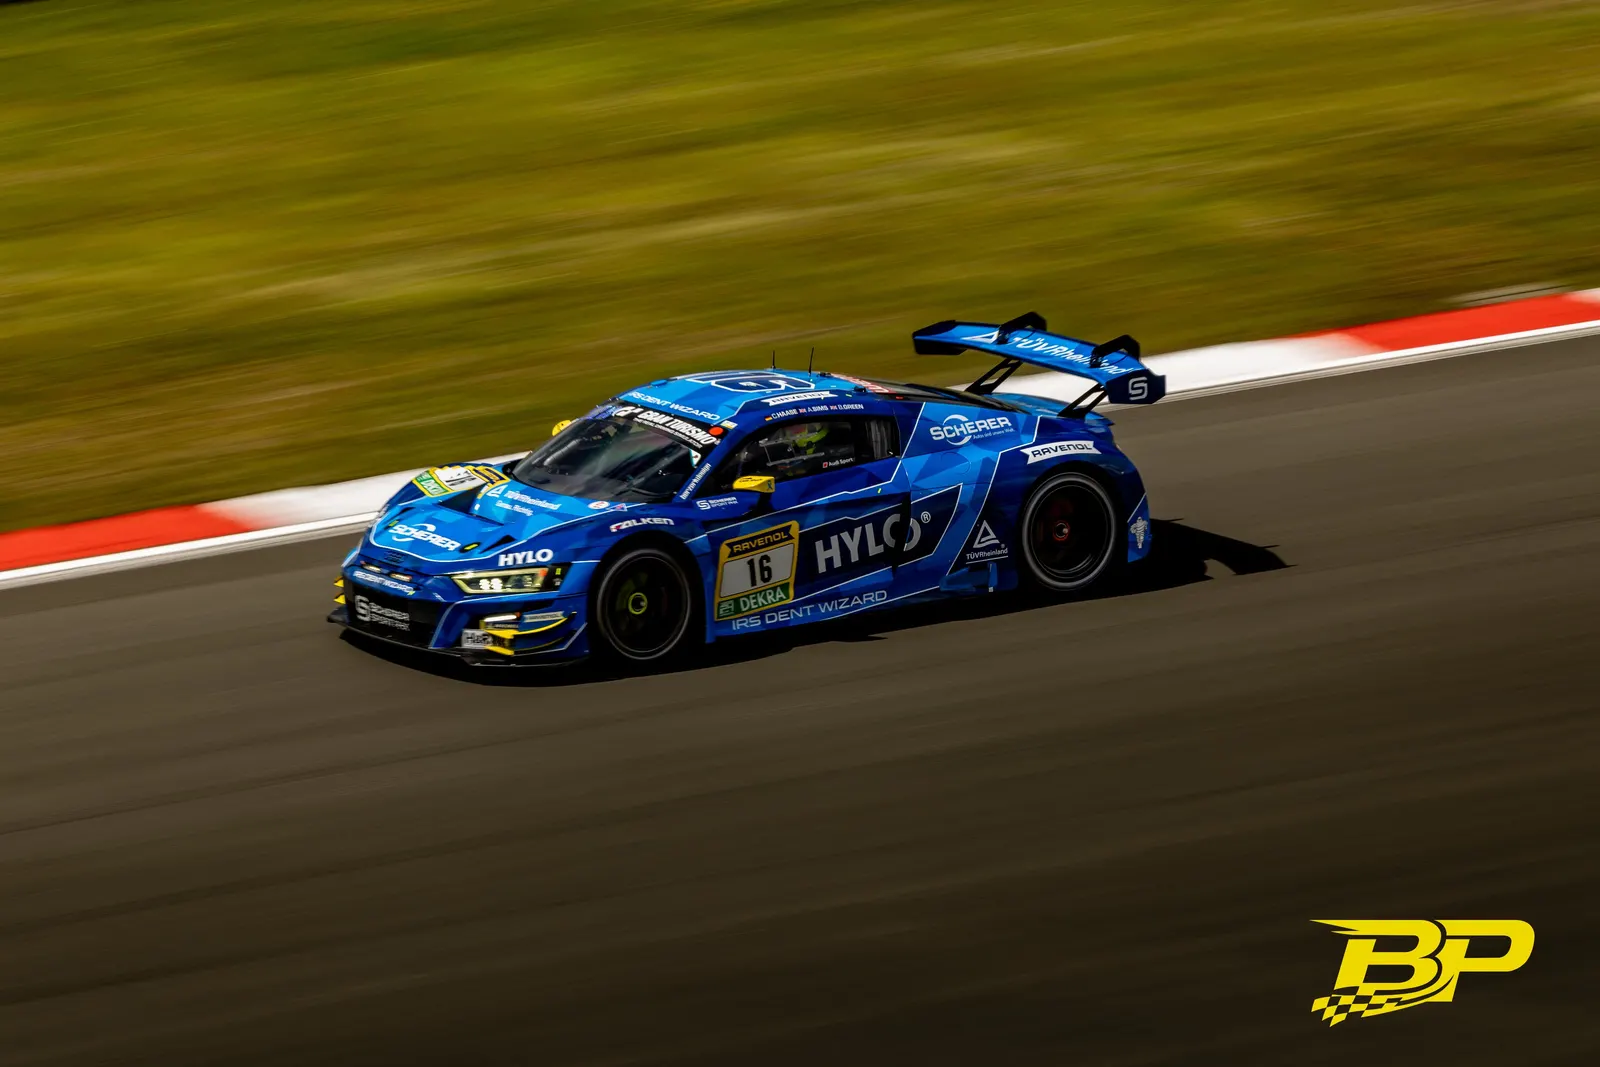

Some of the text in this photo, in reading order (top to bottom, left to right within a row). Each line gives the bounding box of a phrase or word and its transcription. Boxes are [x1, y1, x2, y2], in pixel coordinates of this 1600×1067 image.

[642, 395, 671, 407] DENT
[669, 403, 720, 421] WIZARD
[637, 410, 672, 427] GRAN
[667, 418, 717, 445] TURISMO
[929, 416, 1012, 441] SCHERER
[1031, 442, 1092, 458] RAVENOL
[609, 517, 675, 532] FALKEN
[388, 524, 462, 551] SCHERER
[732, 530, 789, 554] RAVENOL
[498, 549, 554, 567] HYLO
[966, 547, 1009, 561] TÜVRheinland
[746, 554, 773, 588] 16
[732, 591, 887, 631] IRS DENT WIZARD
[740, 586, 787, 613] DEKRA
